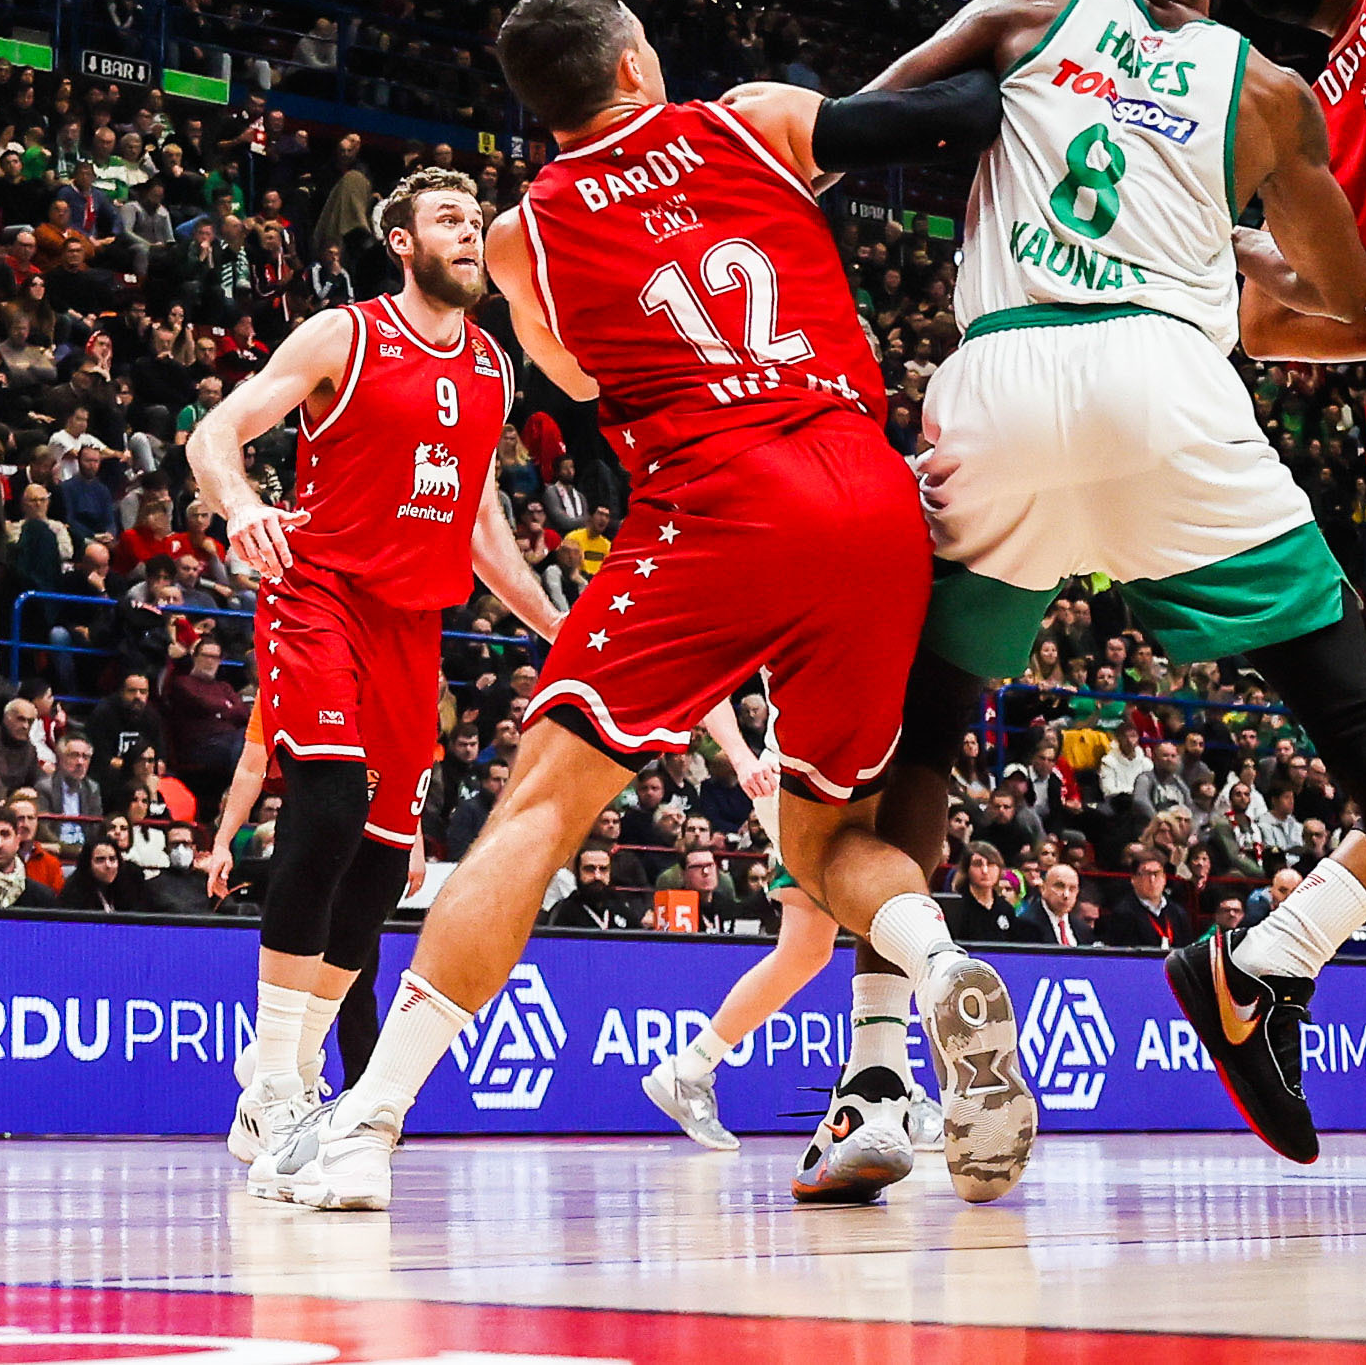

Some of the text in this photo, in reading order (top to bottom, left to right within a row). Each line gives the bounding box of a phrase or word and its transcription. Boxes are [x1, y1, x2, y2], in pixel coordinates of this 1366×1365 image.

[100, 58, 134, 80] BAR
[574, 135, 705, 213] BARON
[1049, 123, 1126, 240] 8
[1009, 220, 1148, 291] KAUNA
[637, 237, 816, 367] 12
[379, 344, 404, 357] EA7
[435, 376, 460, 428] 9
[410, 767, 433, 817] 9
[674, 905, 693, 933] 5
